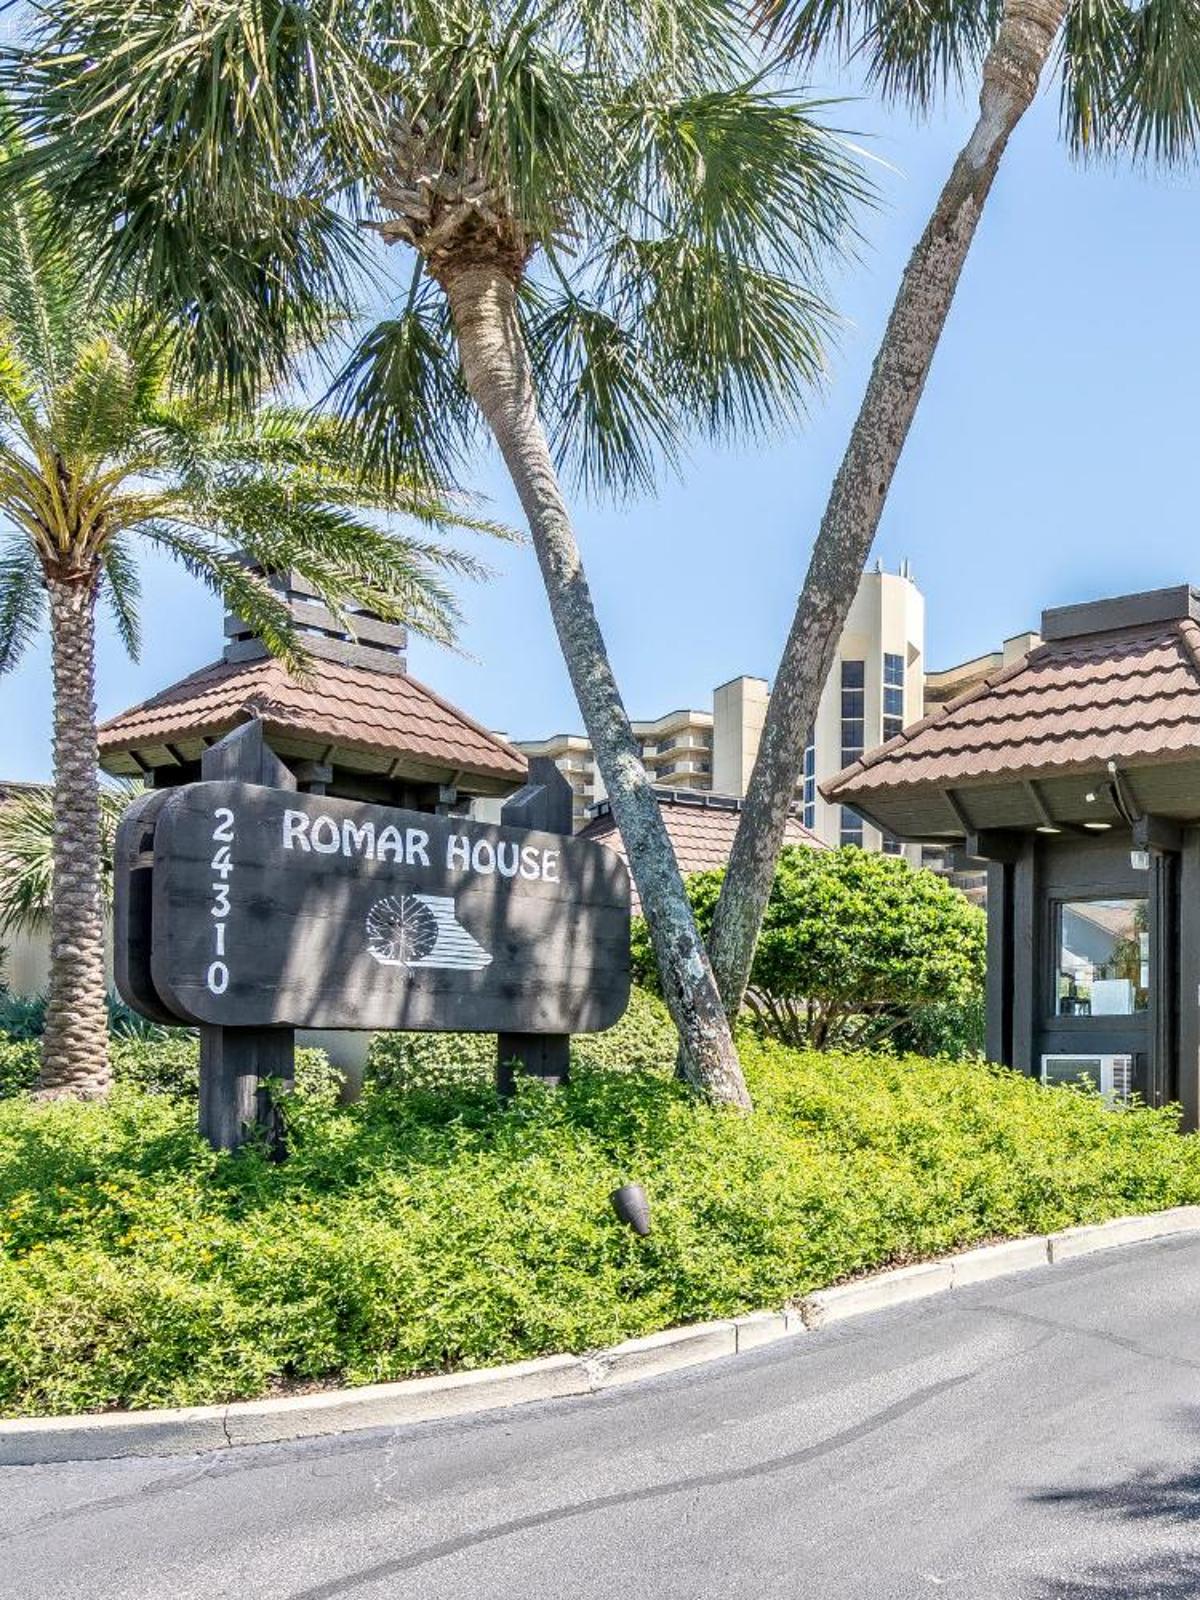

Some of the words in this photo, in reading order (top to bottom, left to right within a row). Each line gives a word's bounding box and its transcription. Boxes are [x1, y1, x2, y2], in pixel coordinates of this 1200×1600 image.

[207, 807, 235, 995] 24310
[282, 809, 431, 866] ROMAR
[446, 834, 561, 884] HOUSE
